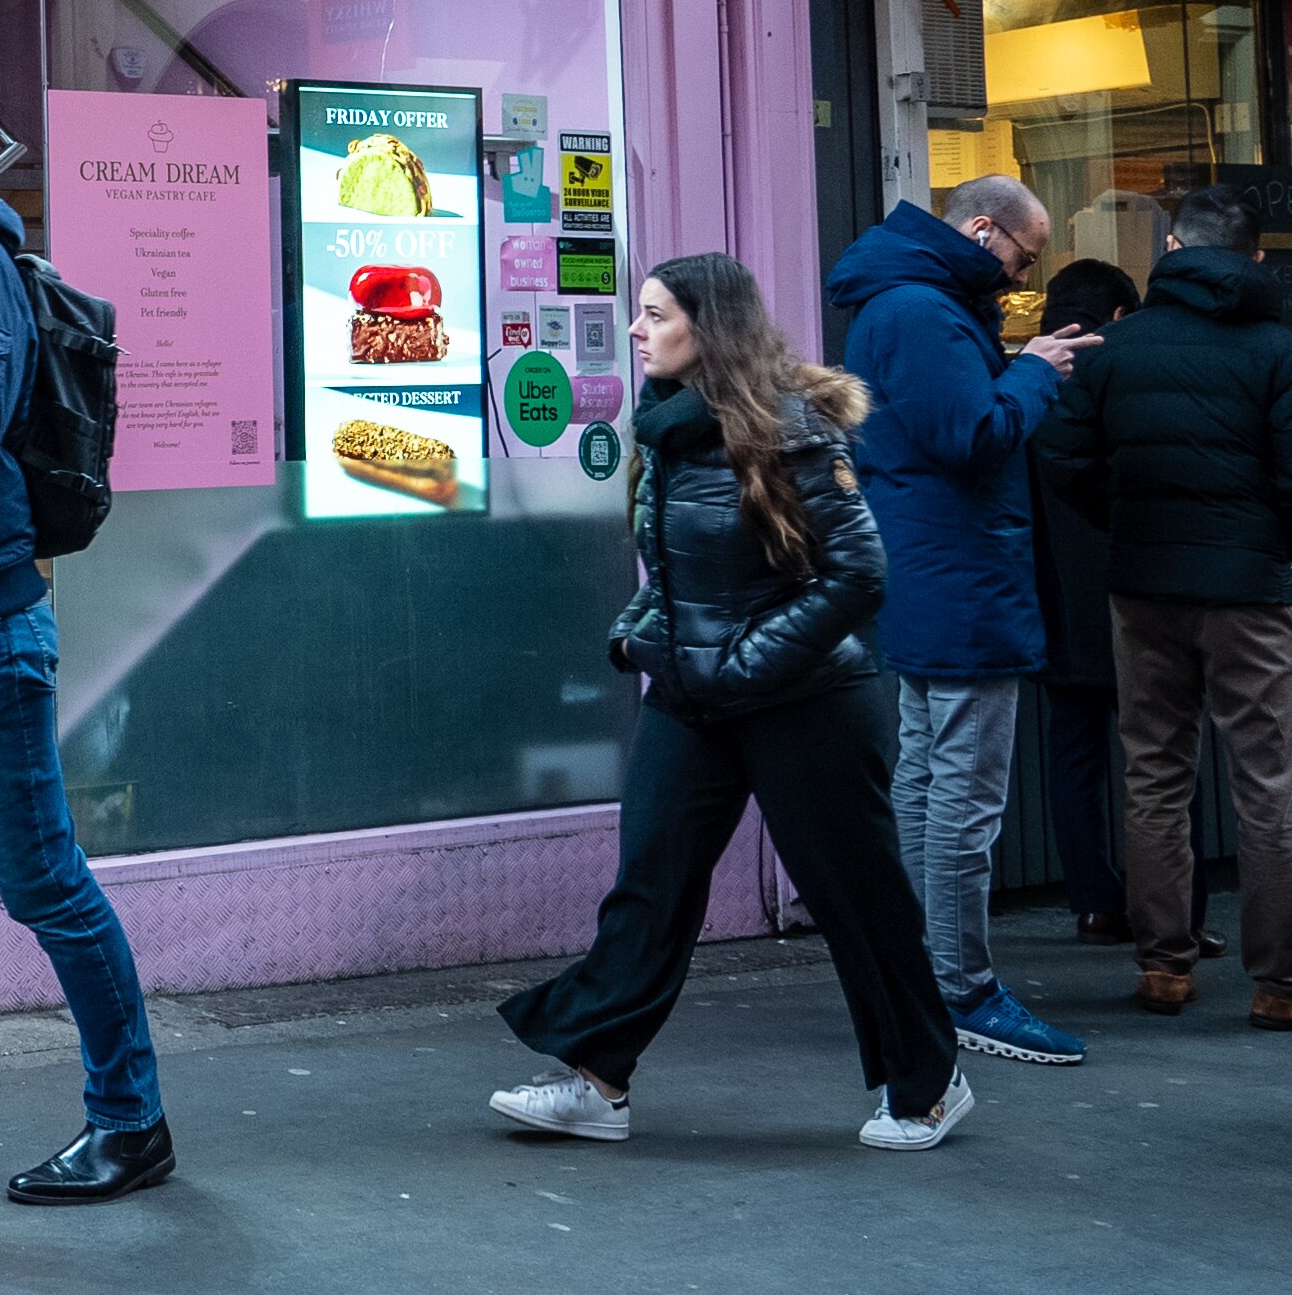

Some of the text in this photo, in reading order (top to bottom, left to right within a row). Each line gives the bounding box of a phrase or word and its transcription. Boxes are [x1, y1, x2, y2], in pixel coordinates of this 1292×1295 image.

[326, 108, 449, 129] FRIDAY OFFER
[562, 136, 609, 151] WARNING
[80, 160, 241, 185] CREAM DREAM
[105, 189, 216, 202] VEGAN PASTRY CAFE
[564, 188, 572, 197] 24
[591, 189, 610, 198] VIDEO
[564, 198, 610, 208] SURVEILLANCE
[129, 227, 196, 240] Speciality coffee
[326, 229, 456, 259] -50% OFF
[512, 240, 546, 250] woman
[135, 247, 191, 258] Ukrainian tea
[514, 258, 543, 269] owned
[151, 267, 176, 279] Vegan
[603, 272, 609, 283] 5
[510, 276, 548, 287] business
[140, 287, 187, 298] Gluten free
[140, 307, 187, 319] Pet friendly
[518, 380, 558, 400] Uber
[581, 383, 614, 395] Student
[401, 390, 462, 406] DESSERT
[520, 403, 558, 421] Eats
